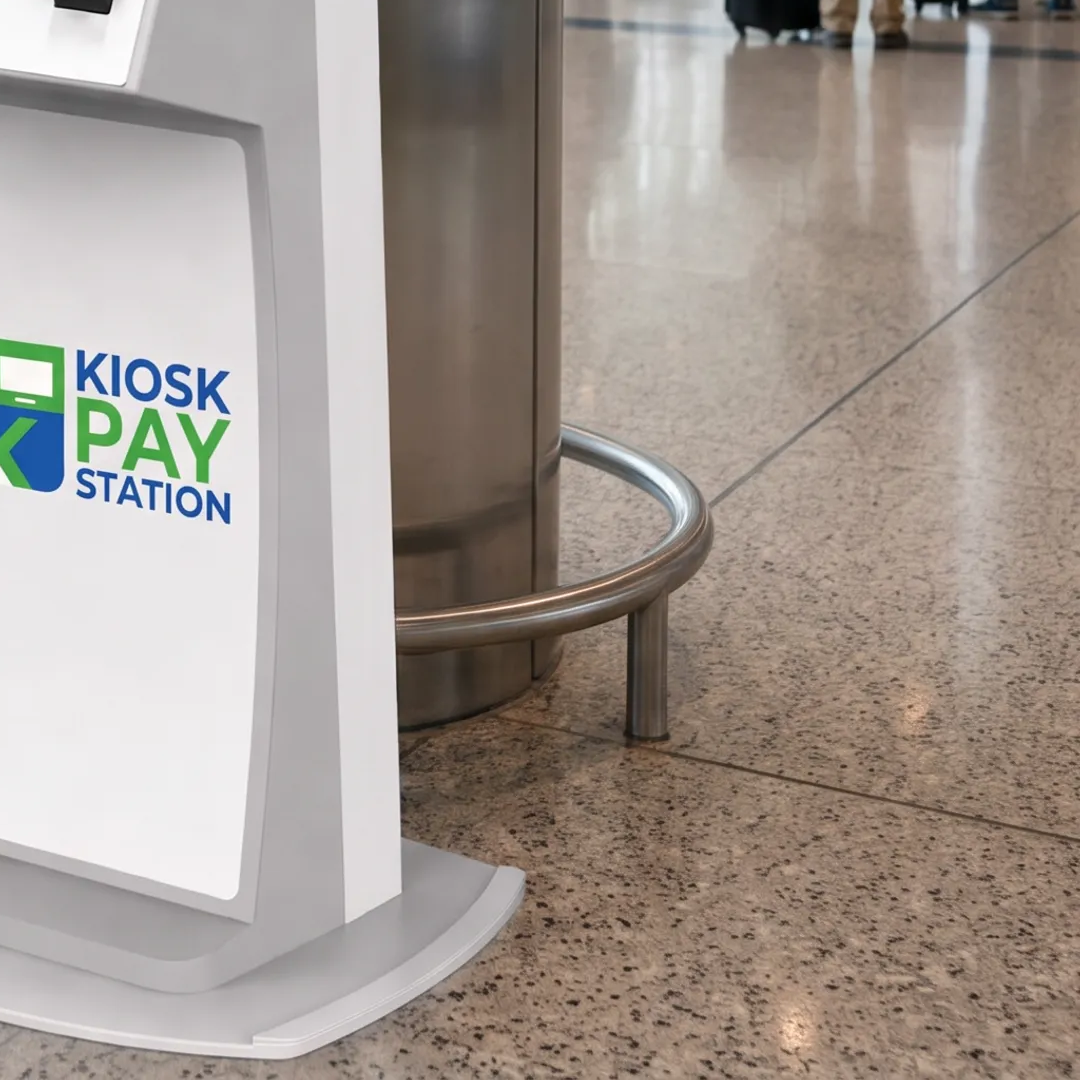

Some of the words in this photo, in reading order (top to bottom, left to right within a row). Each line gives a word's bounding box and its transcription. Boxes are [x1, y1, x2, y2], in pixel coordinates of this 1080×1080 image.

[76, 349, 231, 415] KIOSK
[77, 396, 231, 484] PAY
[76, 468, 231, 525] STATION
